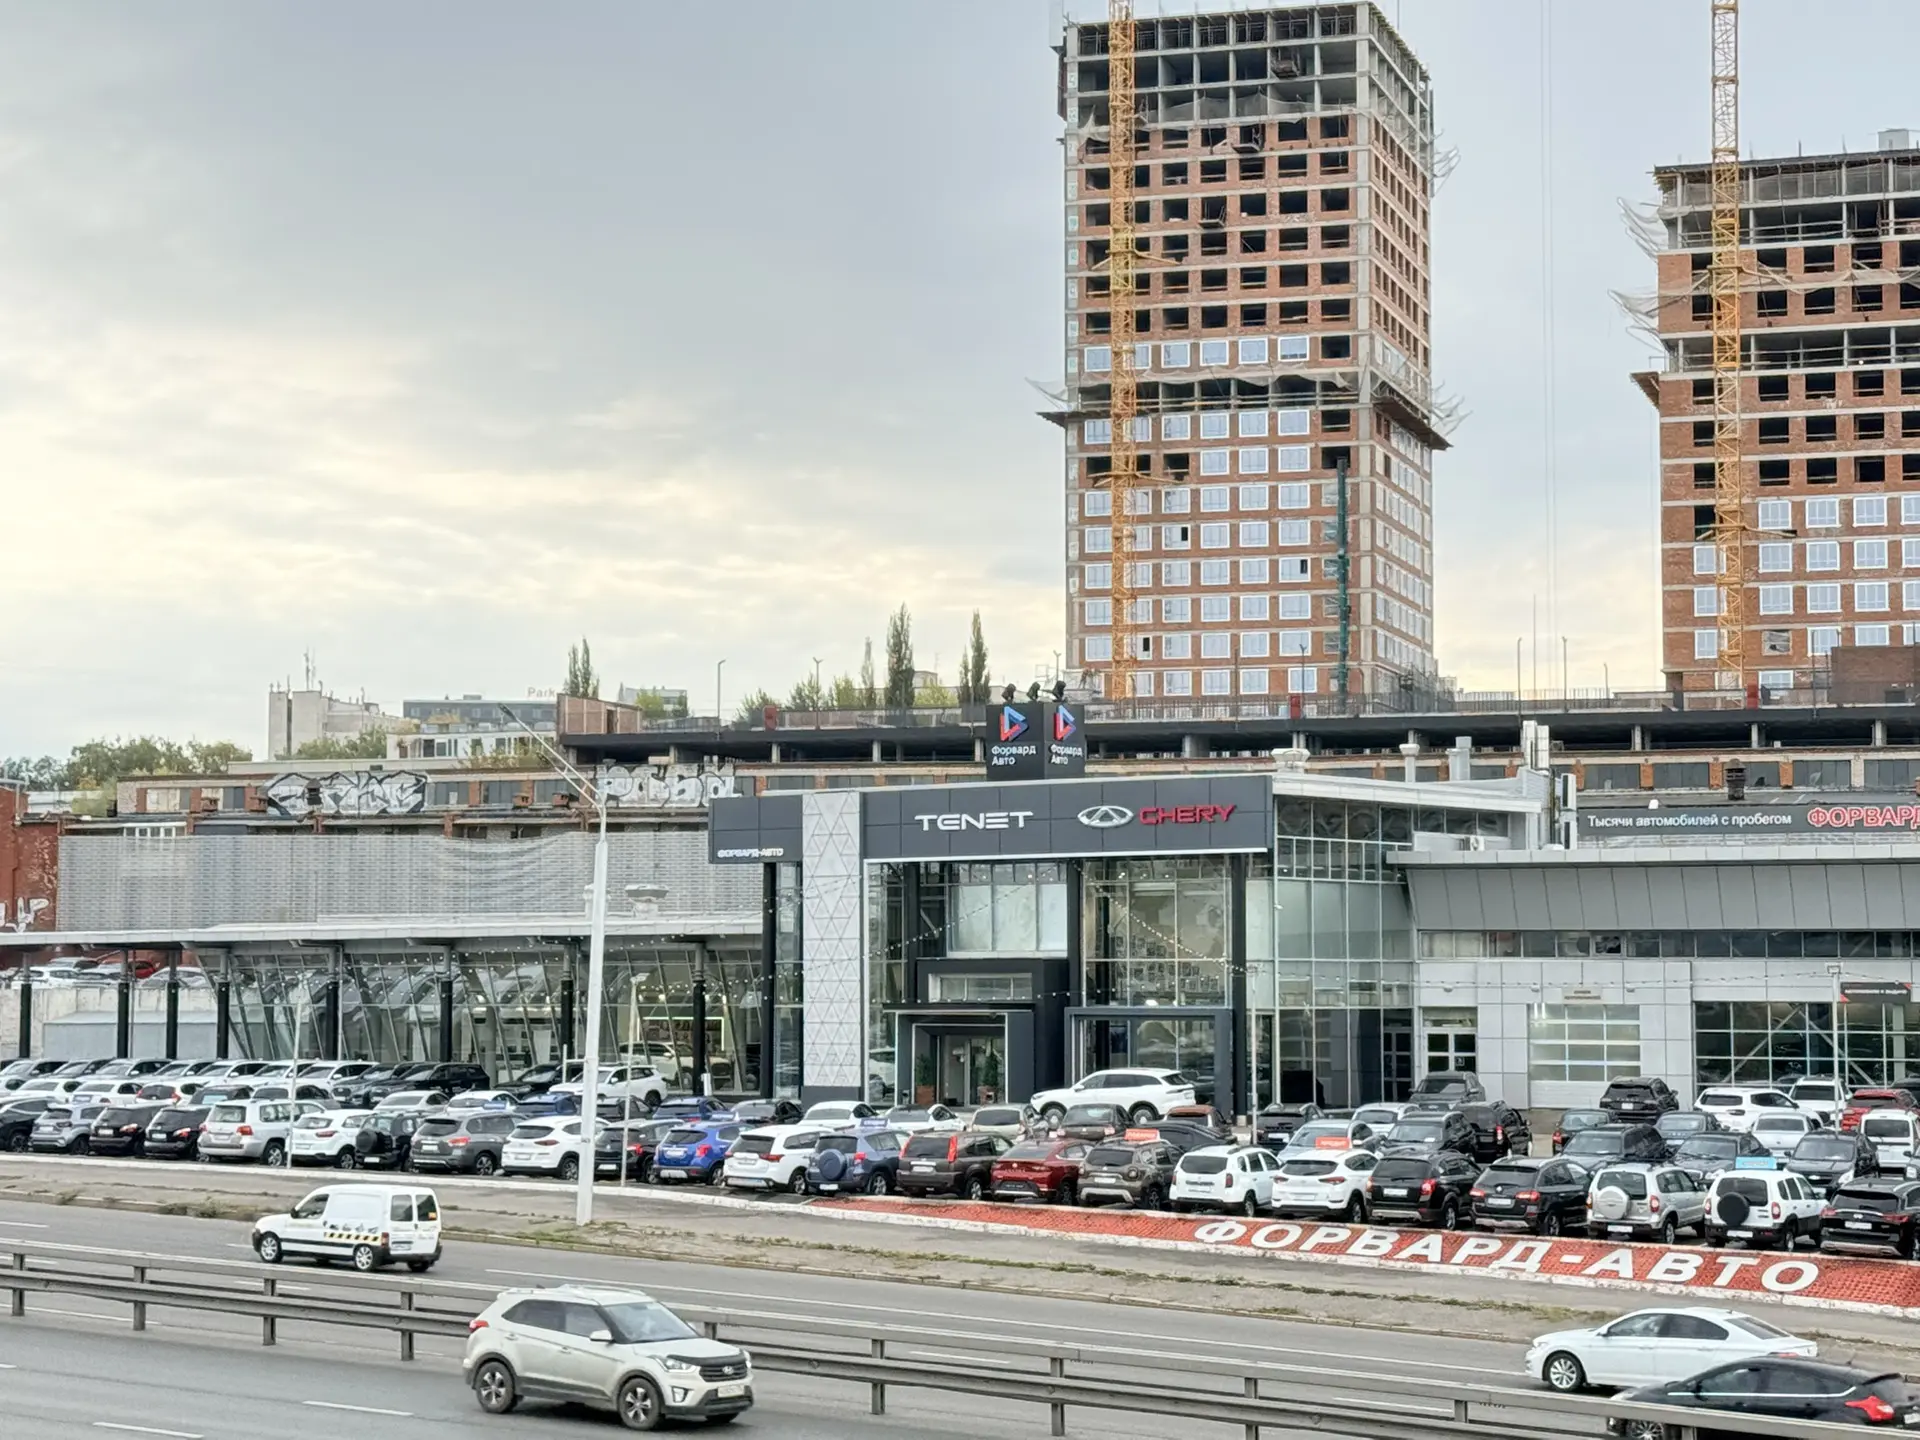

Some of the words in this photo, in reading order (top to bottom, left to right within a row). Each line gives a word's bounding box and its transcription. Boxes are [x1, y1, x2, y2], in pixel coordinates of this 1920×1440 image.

[991, 745, 1037, 757] Форвард
[1050, 743, 1083, 757] Форвард
[991, 756, 1016, 766] Авто
[1050, 754, 1069, 765] Авто
[914, 811, 1034, 832] TENET
[1137, 804, 1237, 826] CHERY
[1587, 815, 1634, 828] Тысячи
[1635, 813, 1719, 828] автомобилей
[1721, 817, 1729, 826] с
[1731, 813, 1792, 829] пробегом
[1194, 1220, 1820, 1293] ФОРВАРД-АВТО
